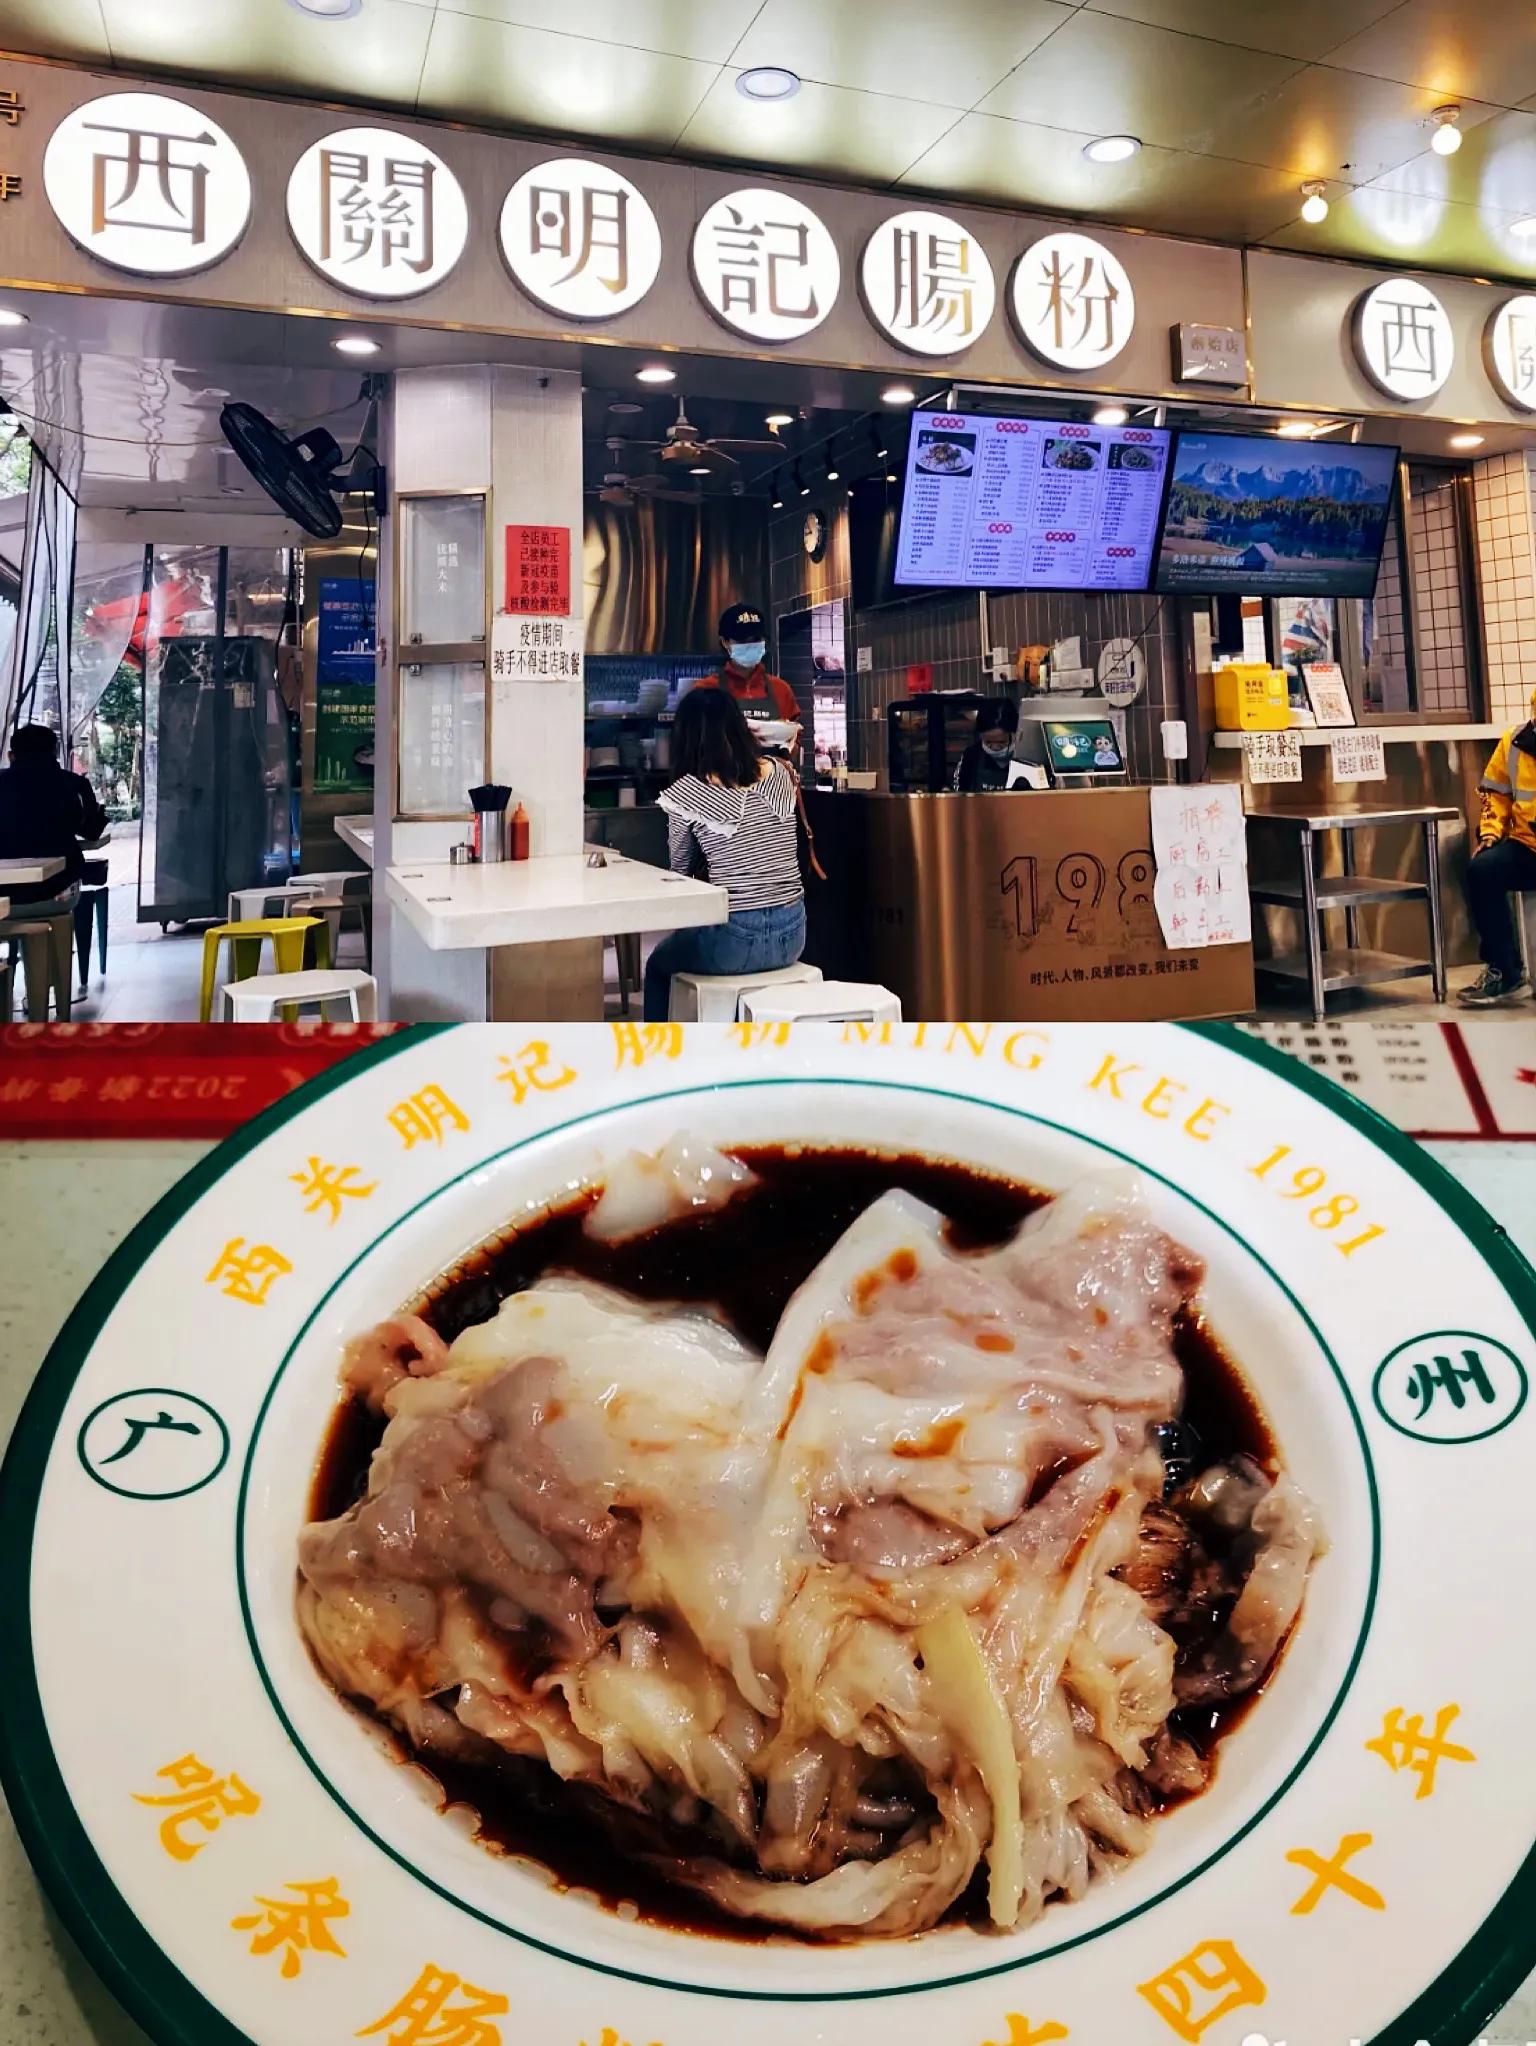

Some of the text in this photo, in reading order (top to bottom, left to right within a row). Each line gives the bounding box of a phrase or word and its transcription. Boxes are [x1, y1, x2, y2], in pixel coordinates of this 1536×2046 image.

[82, 120, 1119, 352] 西關明記腸粉
[494, 650, 580, 676] 骑手不得进店取餐
[520, 621, 564, 648] 疫情期间
[1086, 1053, 1232, 1142] KEE
[1246, 1144, 1388, 1259] 1981
[1405, 1350, 1496, 1420] 州
[101, 1410, 201, 1465] 广
